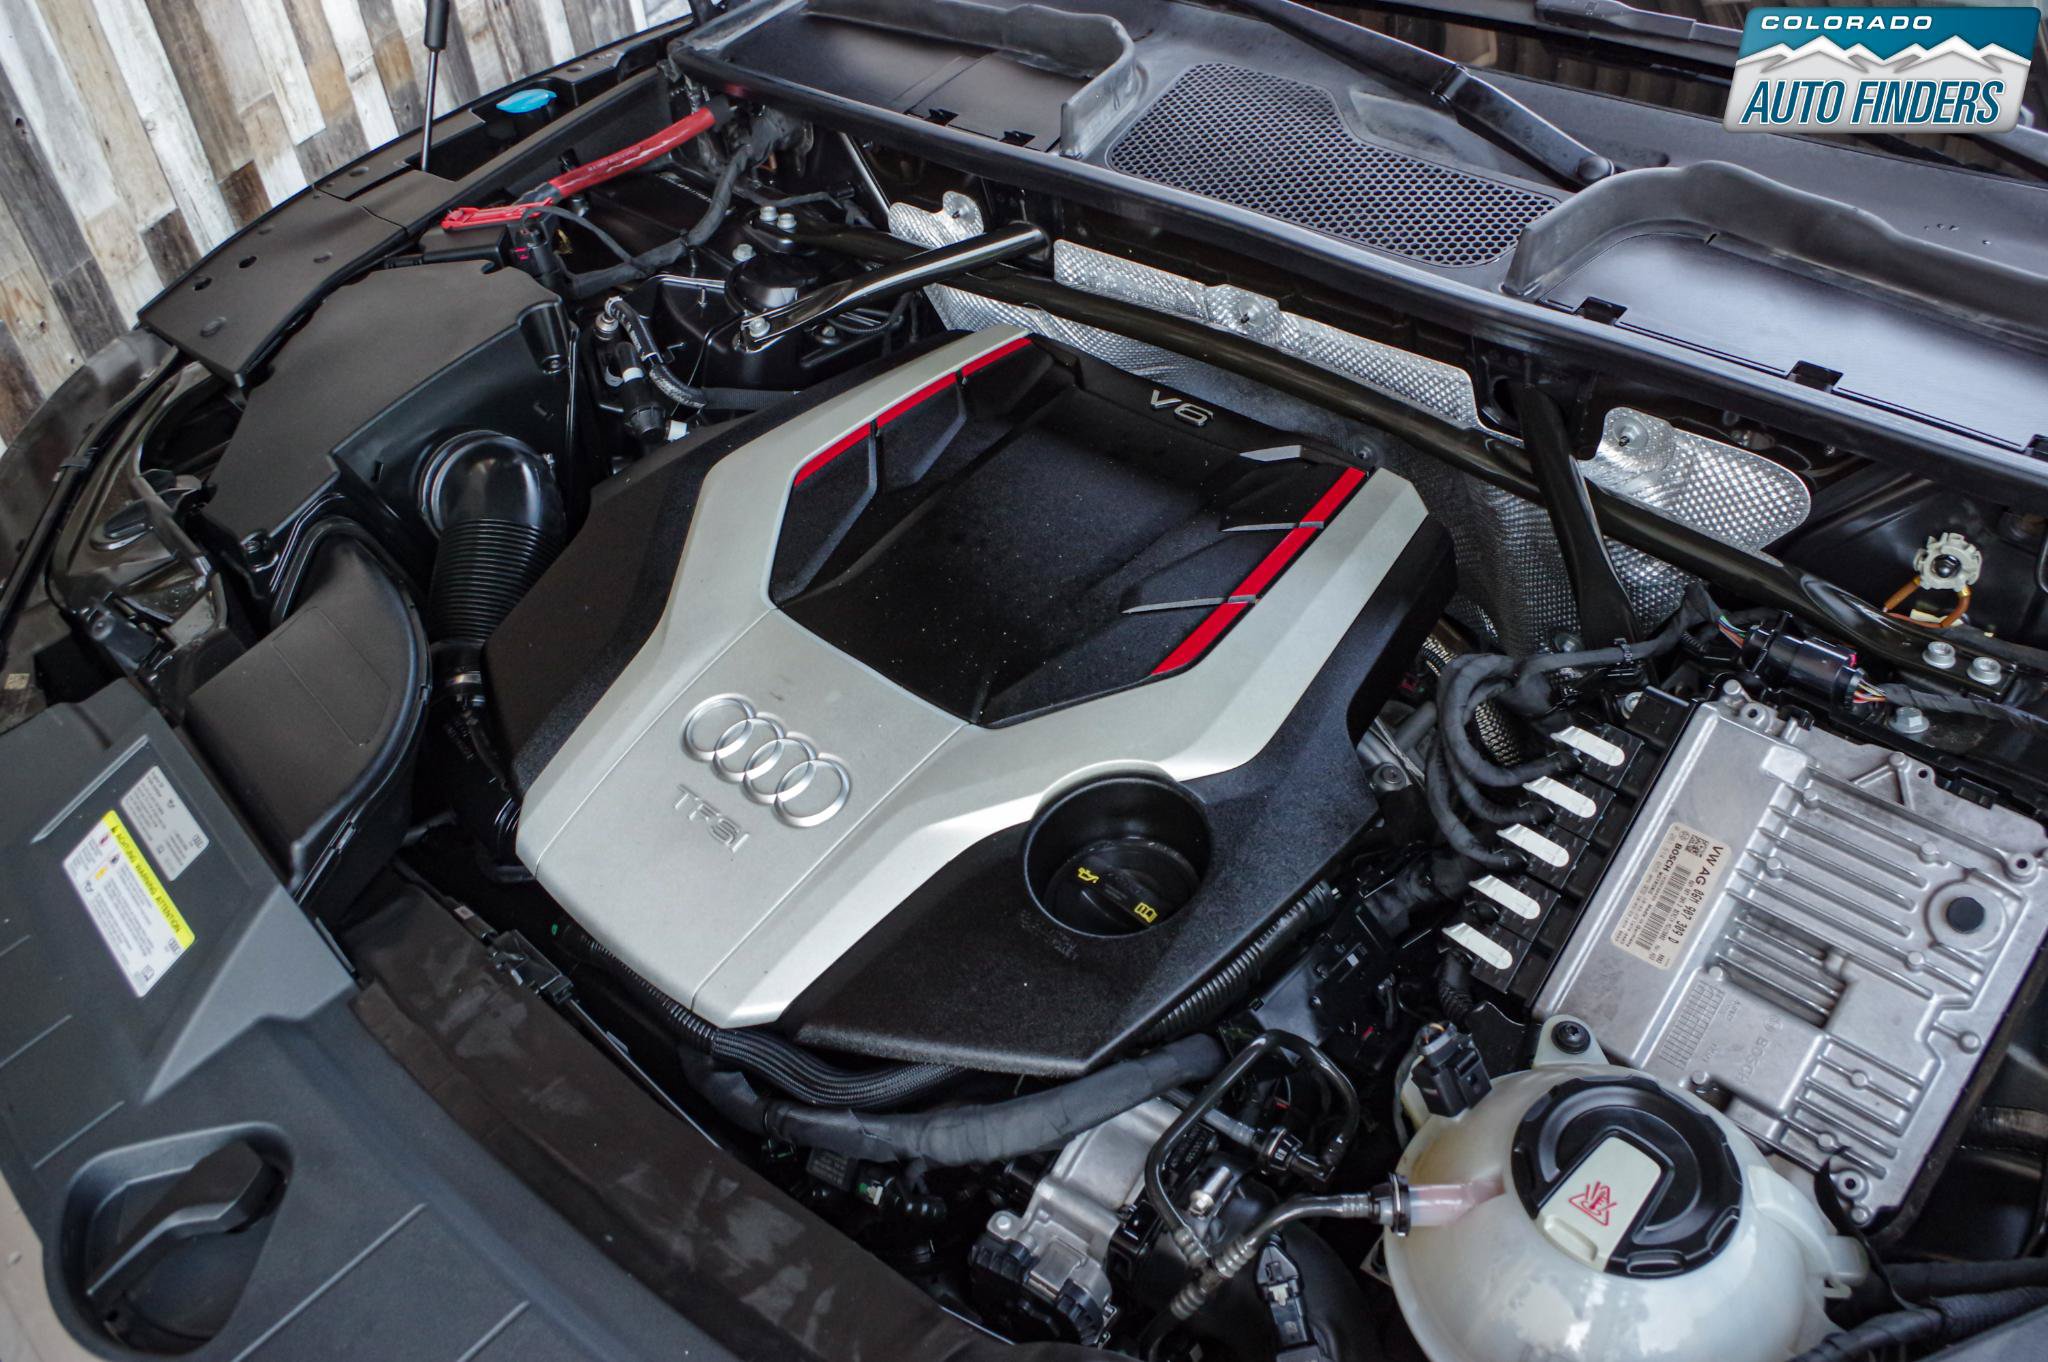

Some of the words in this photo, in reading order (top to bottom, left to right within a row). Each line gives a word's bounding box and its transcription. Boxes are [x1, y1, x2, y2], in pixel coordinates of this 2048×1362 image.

[1151, 389, 1214, 427] V6
[675, 784, 749, 853] TFSI
[1663, 842, 1682, 872] BOSCH
[1705, 843, 1723, 866] VW
[1694, 865, 1711, 886] AG
[1680, 903, 1696, 920] 907
[1671, 920, 1687, 937] 309
[1735, 1036, 1769, 1083] BOSCH
